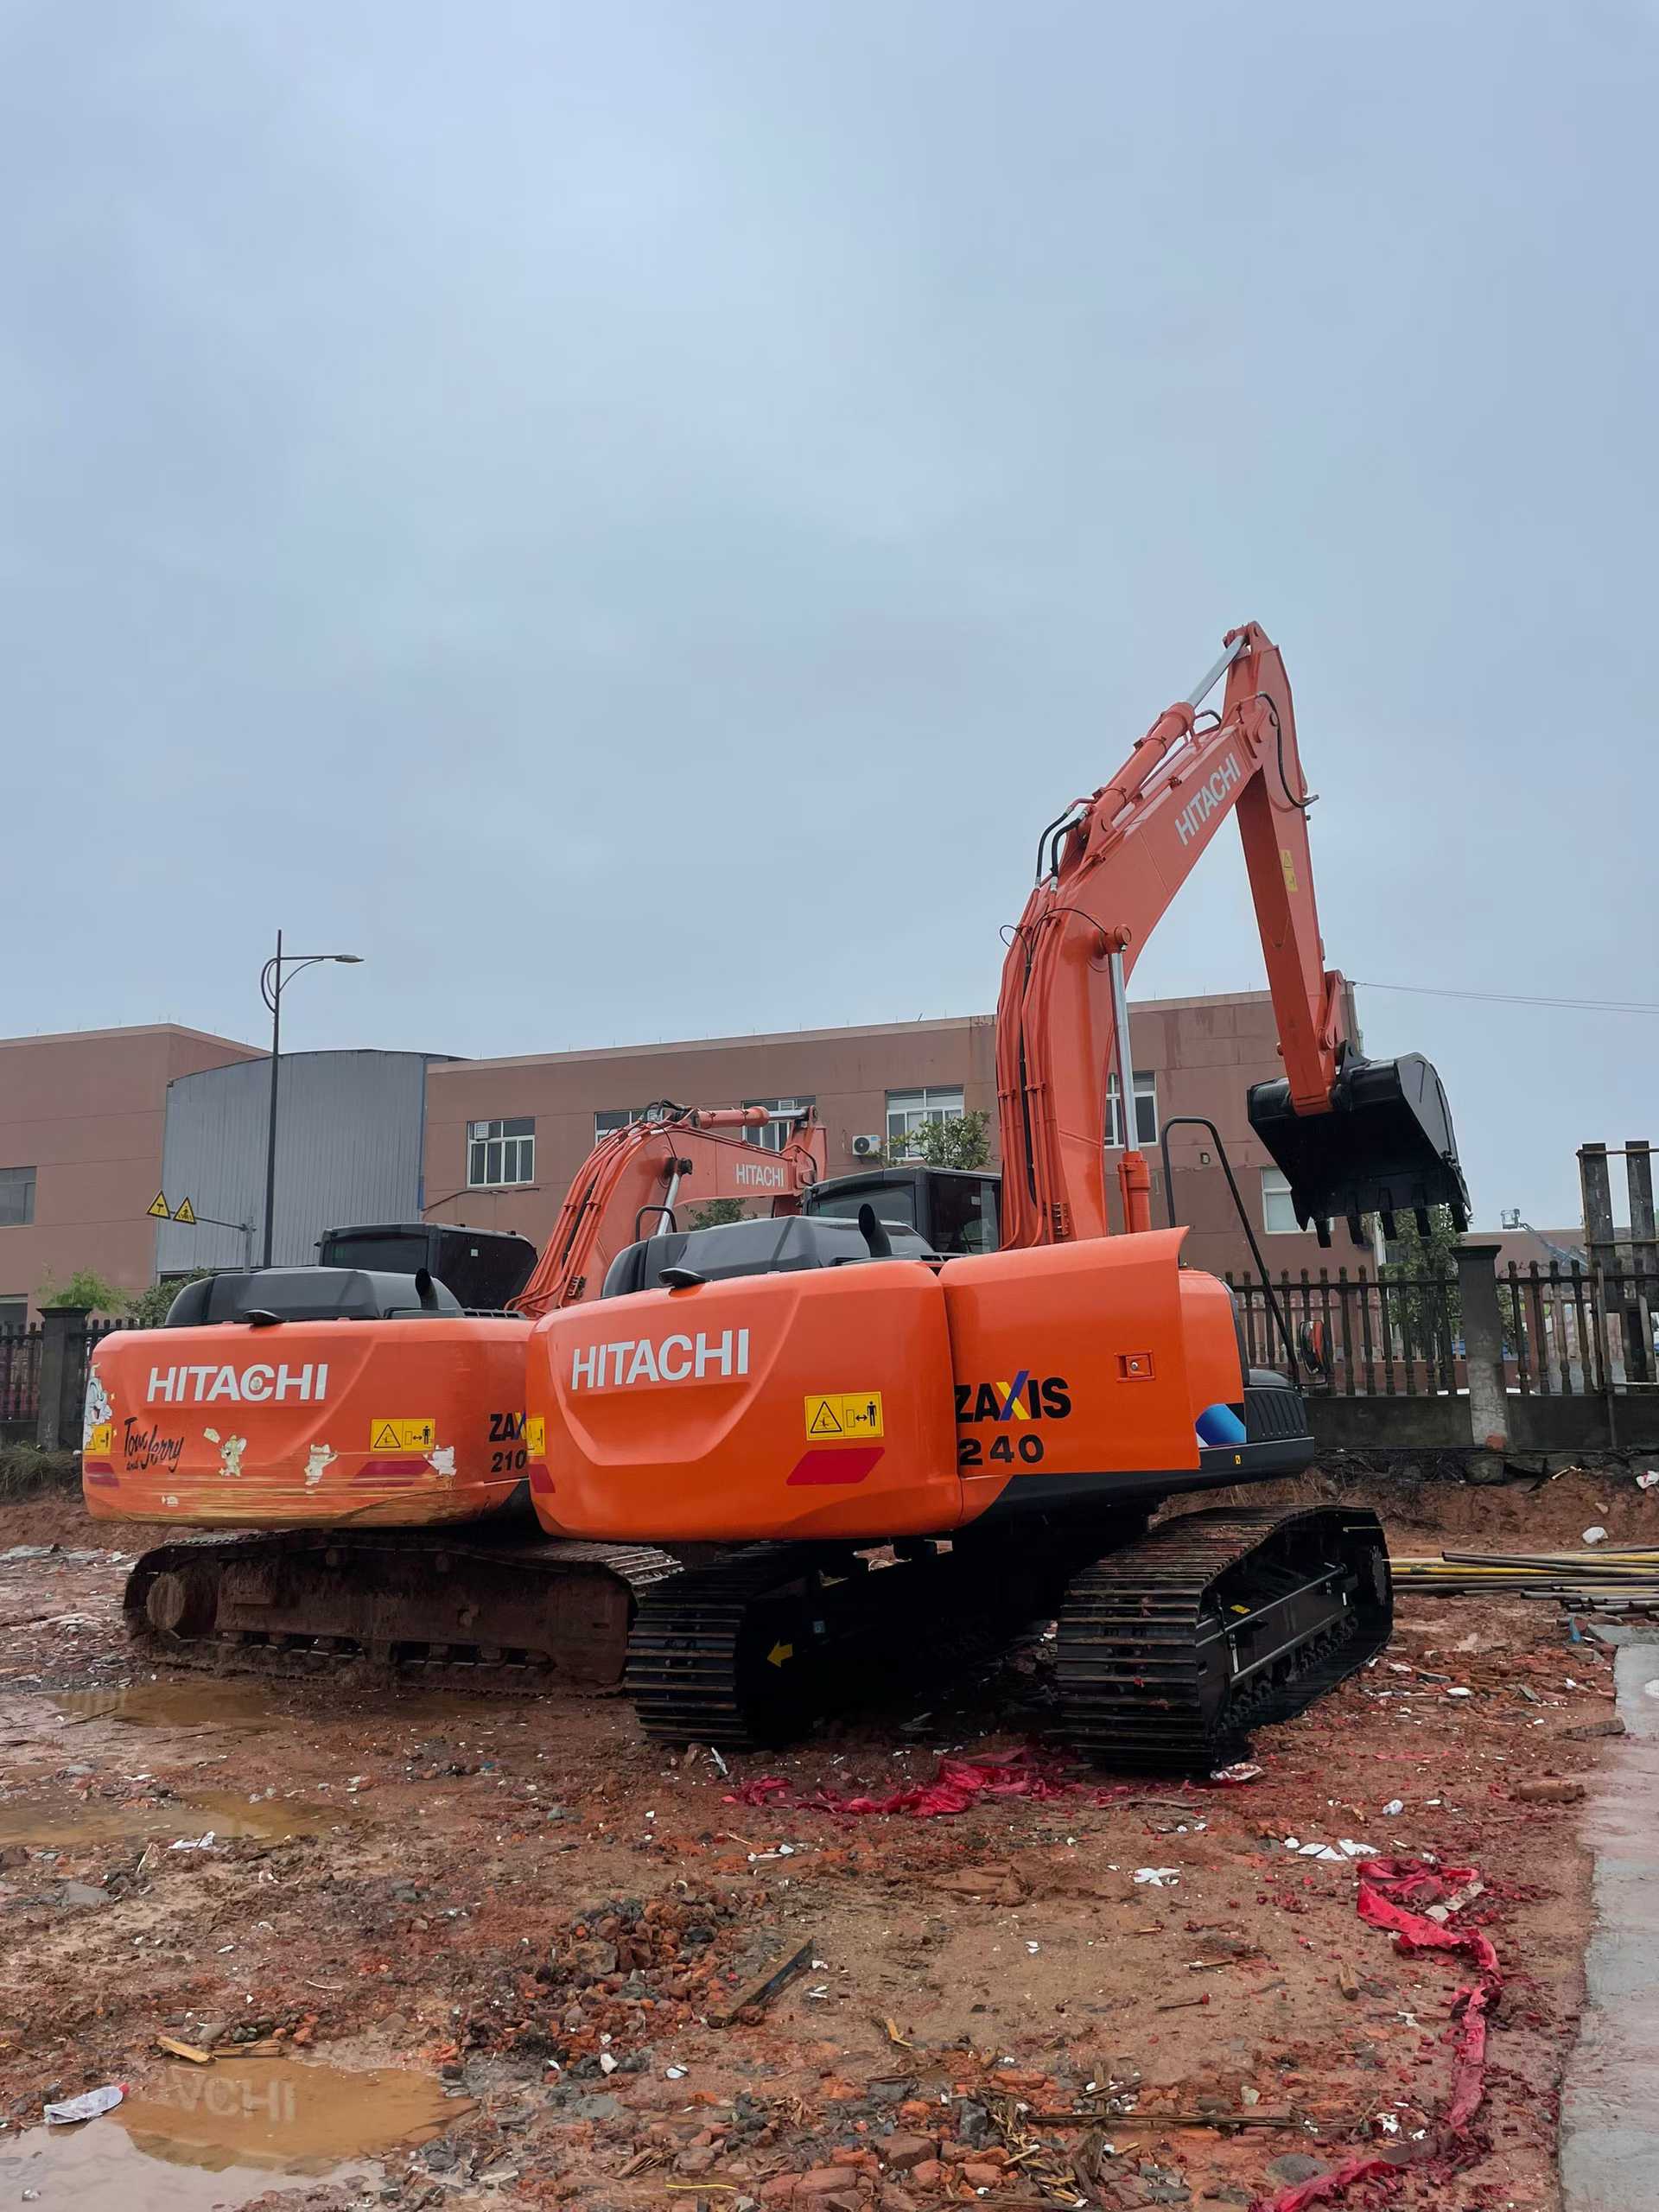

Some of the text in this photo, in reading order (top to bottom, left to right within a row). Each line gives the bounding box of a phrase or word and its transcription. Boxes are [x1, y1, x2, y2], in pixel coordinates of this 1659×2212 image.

[1175, 753, 1241, 846] HITACHI
[735, 1163, 784, 1187] HITACHI
[569, 1328, 749, 1390] HITACHI
[146, 1363, 328, 1402] HITACHI
[954, 1370, 1071, 1424] ZAXIS
[488, 1410, 526, 1443] ZAX
[490, 1449, 526, 1473] 210
[958, 1434, 1045, 1465] 240
